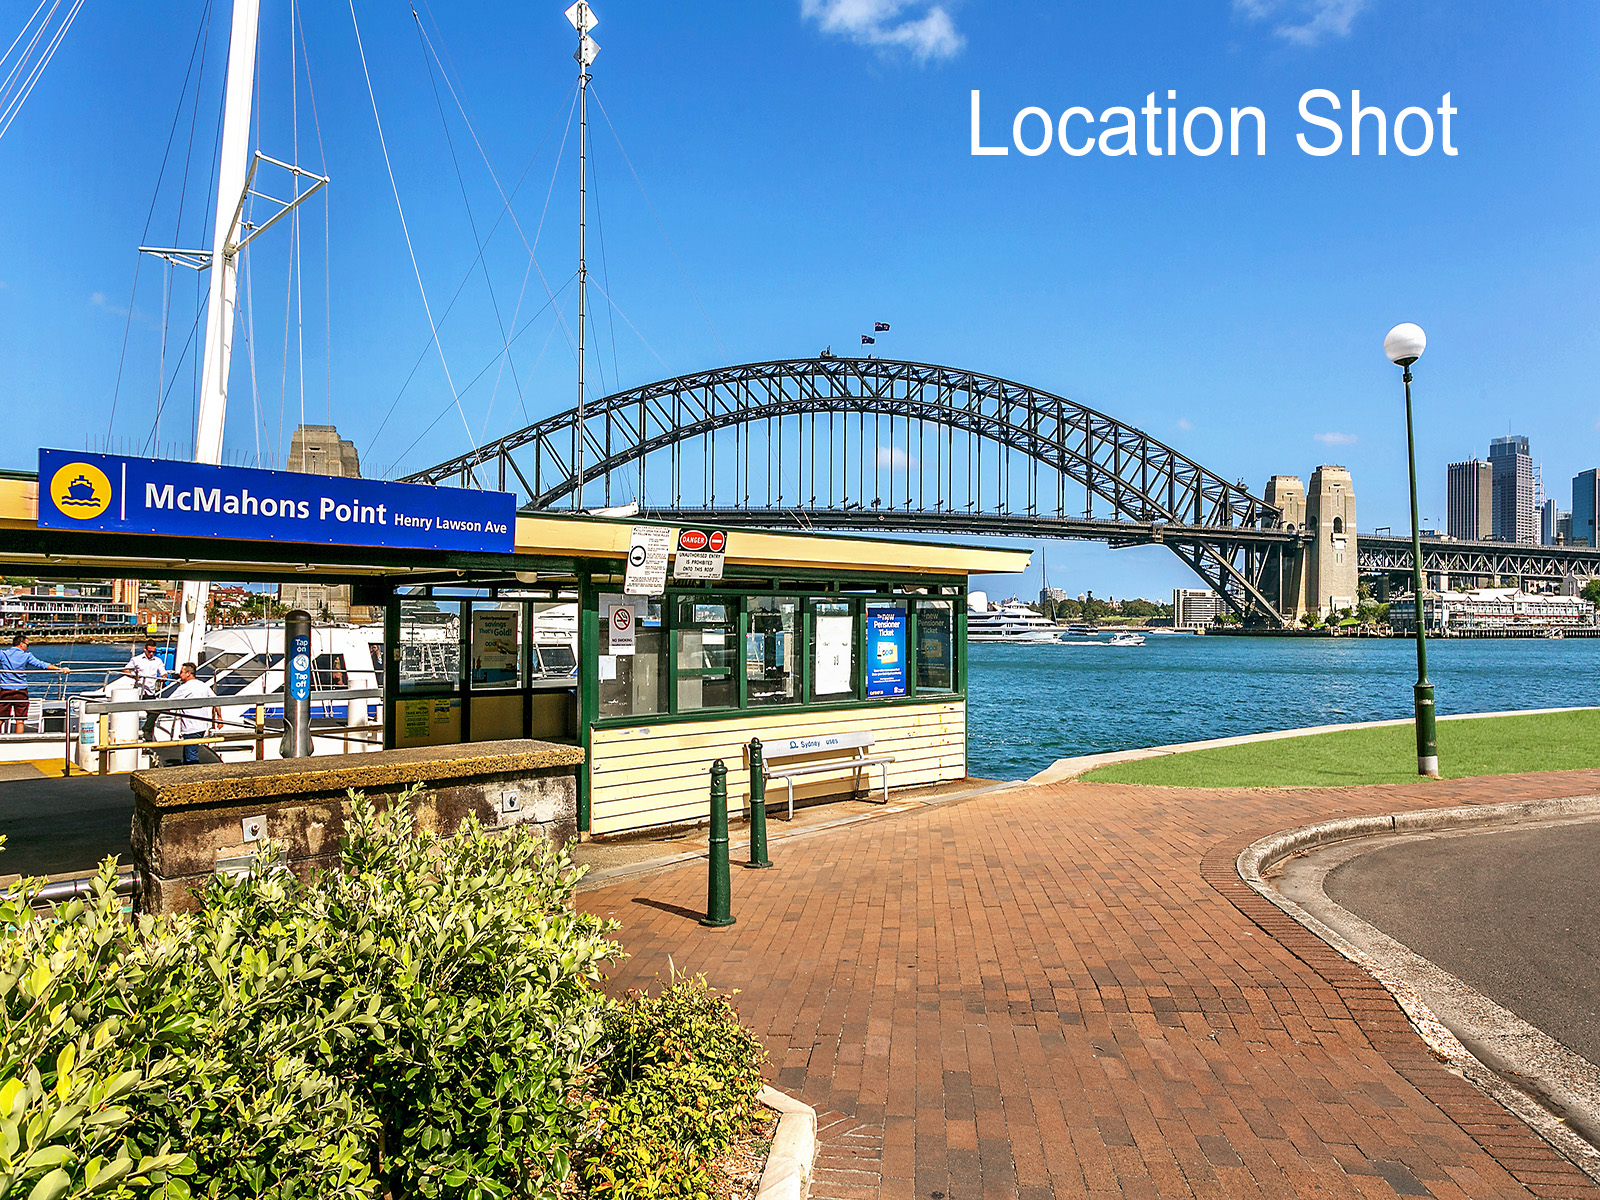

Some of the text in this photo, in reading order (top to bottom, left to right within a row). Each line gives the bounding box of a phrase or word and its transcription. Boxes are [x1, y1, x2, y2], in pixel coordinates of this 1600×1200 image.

[145, 482, 508, 534] McMahons Point Henry Lawson Ave
[683, 536, 704, 544] DANGER
[485, 621, 506, 629] savings
[873, 620, 900, 628] Pensioner
[494, 628, 512, 636] Gold!
